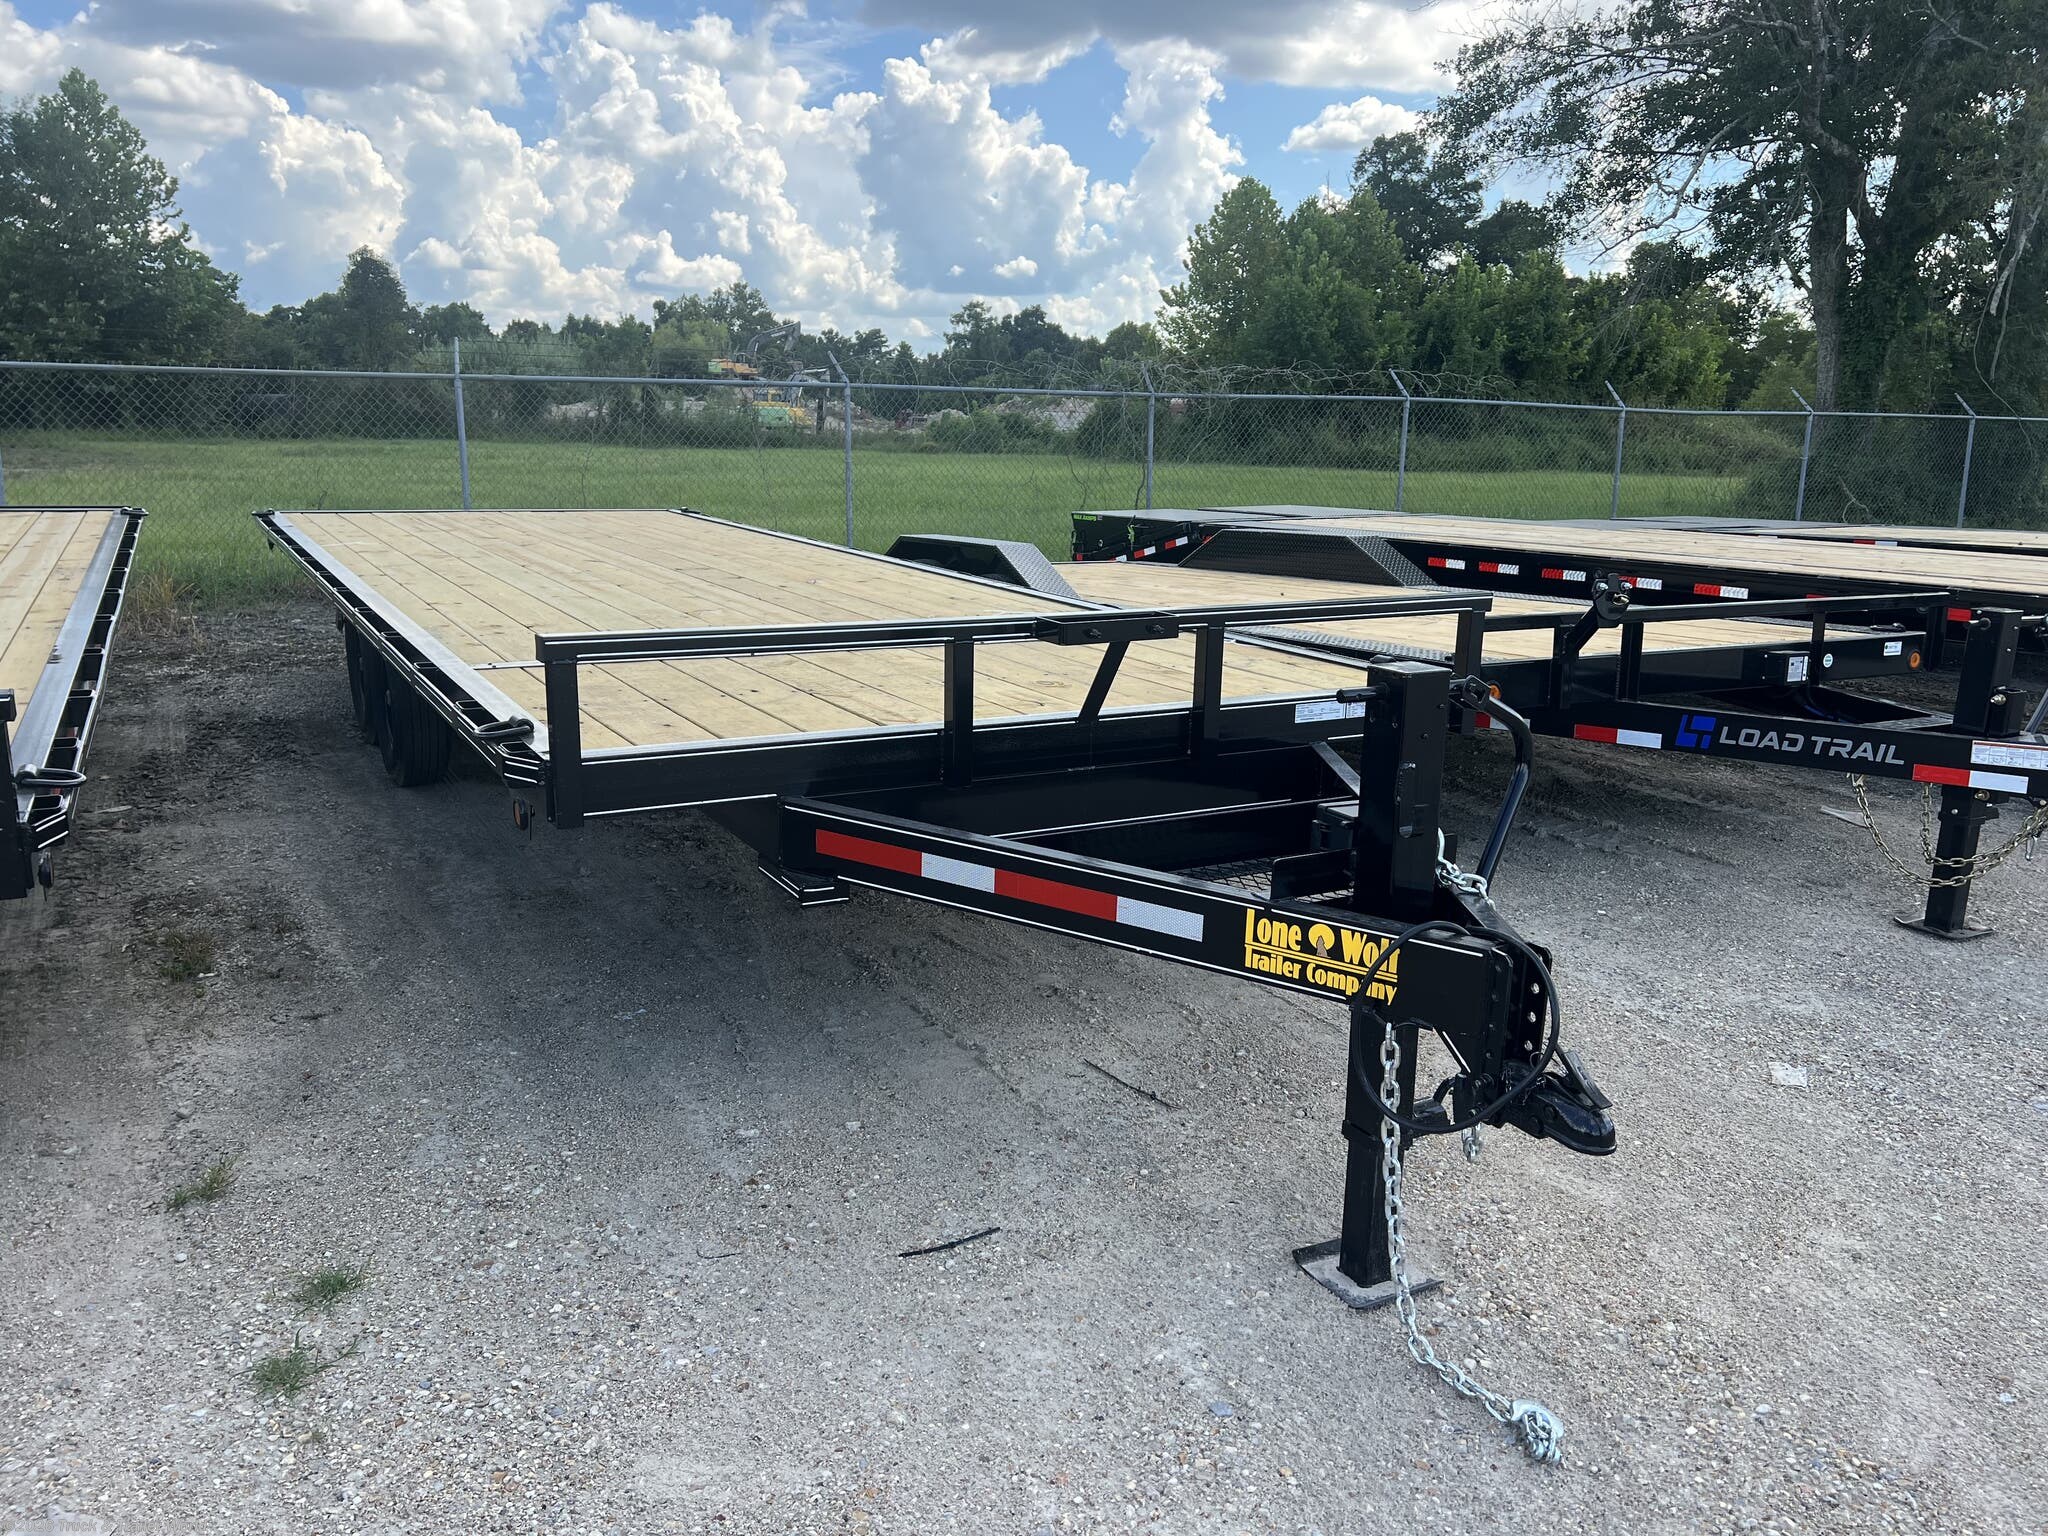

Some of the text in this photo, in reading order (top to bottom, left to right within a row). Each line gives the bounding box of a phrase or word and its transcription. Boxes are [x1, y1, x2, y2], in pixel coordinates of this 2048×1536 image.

[1719, 726, 1905, 765] LOAD TRAIL
[1245, 908, 1302, 951] Lone
[1245, 946, 1302, 980] Trailer
